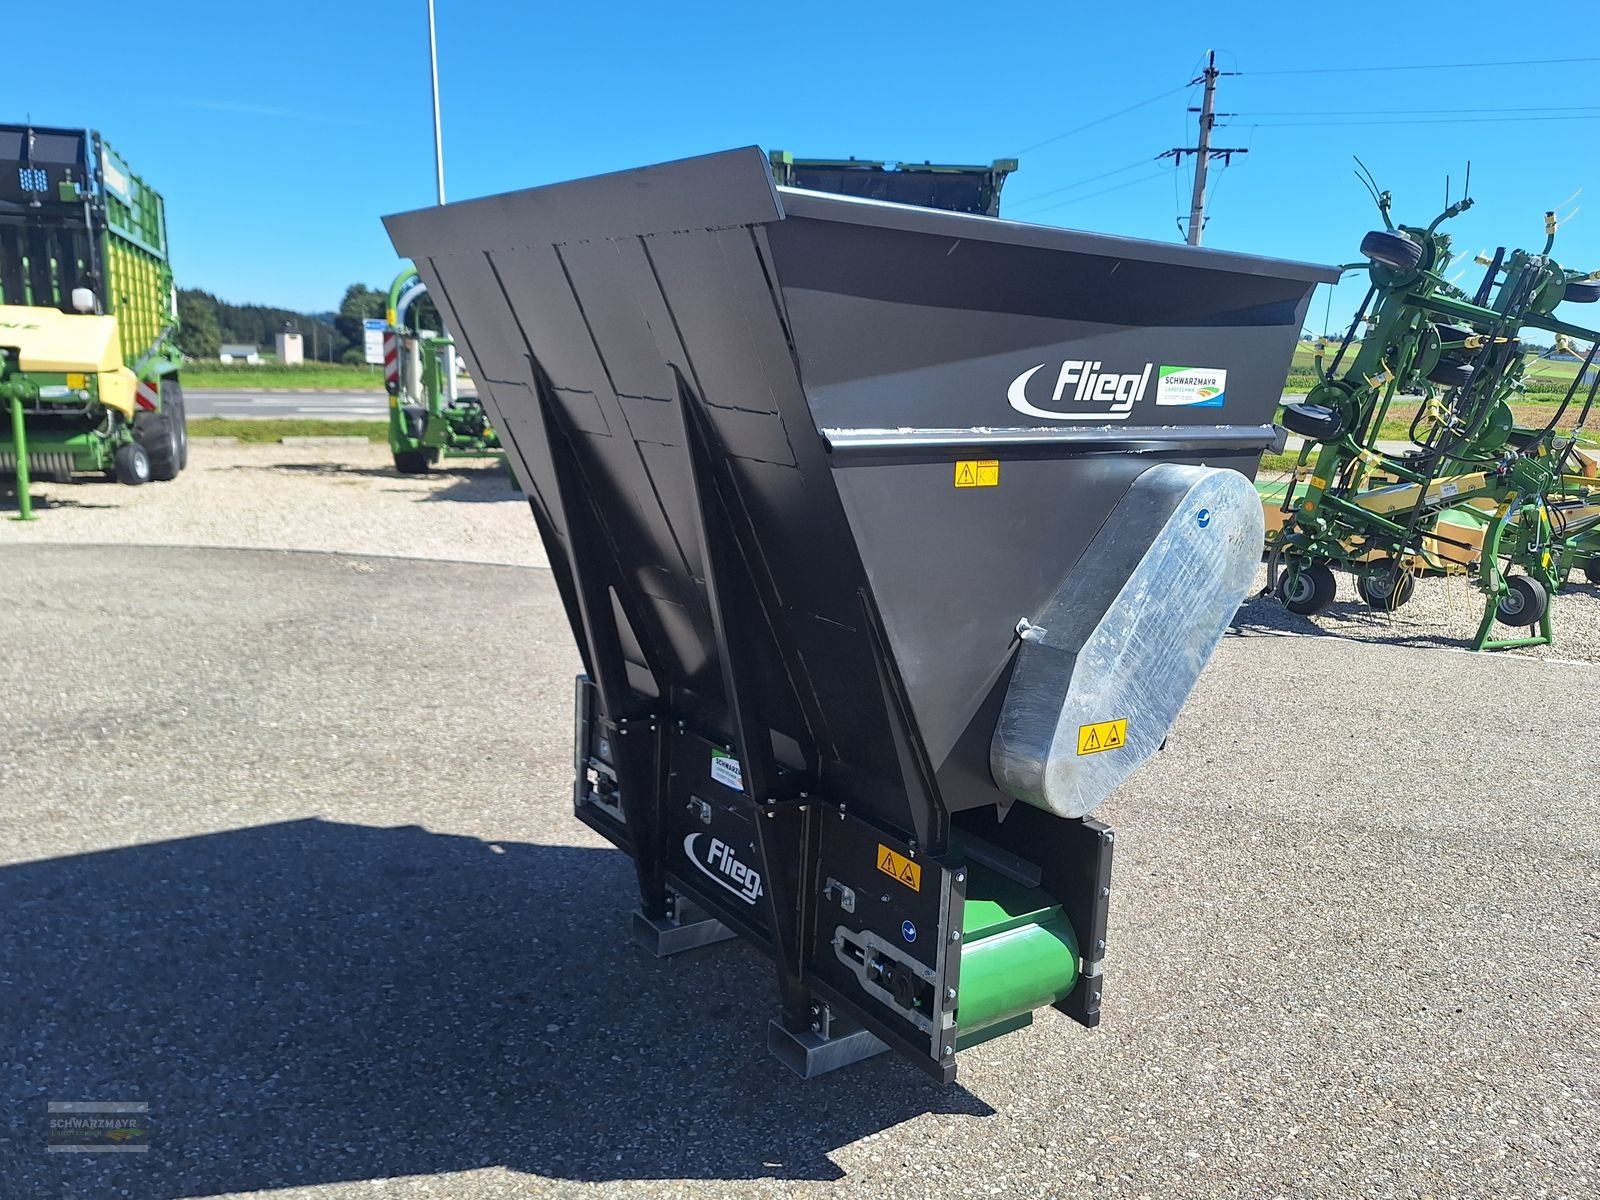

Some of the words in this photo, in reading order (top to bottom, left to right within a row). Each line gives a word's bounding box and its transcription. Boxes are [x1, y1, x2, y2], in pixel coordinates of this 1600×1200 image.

[1052, 360, 1154, 412] Fliegl
[1165, 376, 1217, 386] SCHWARZMAYR
[707, 837, 764, 900] Flieg
